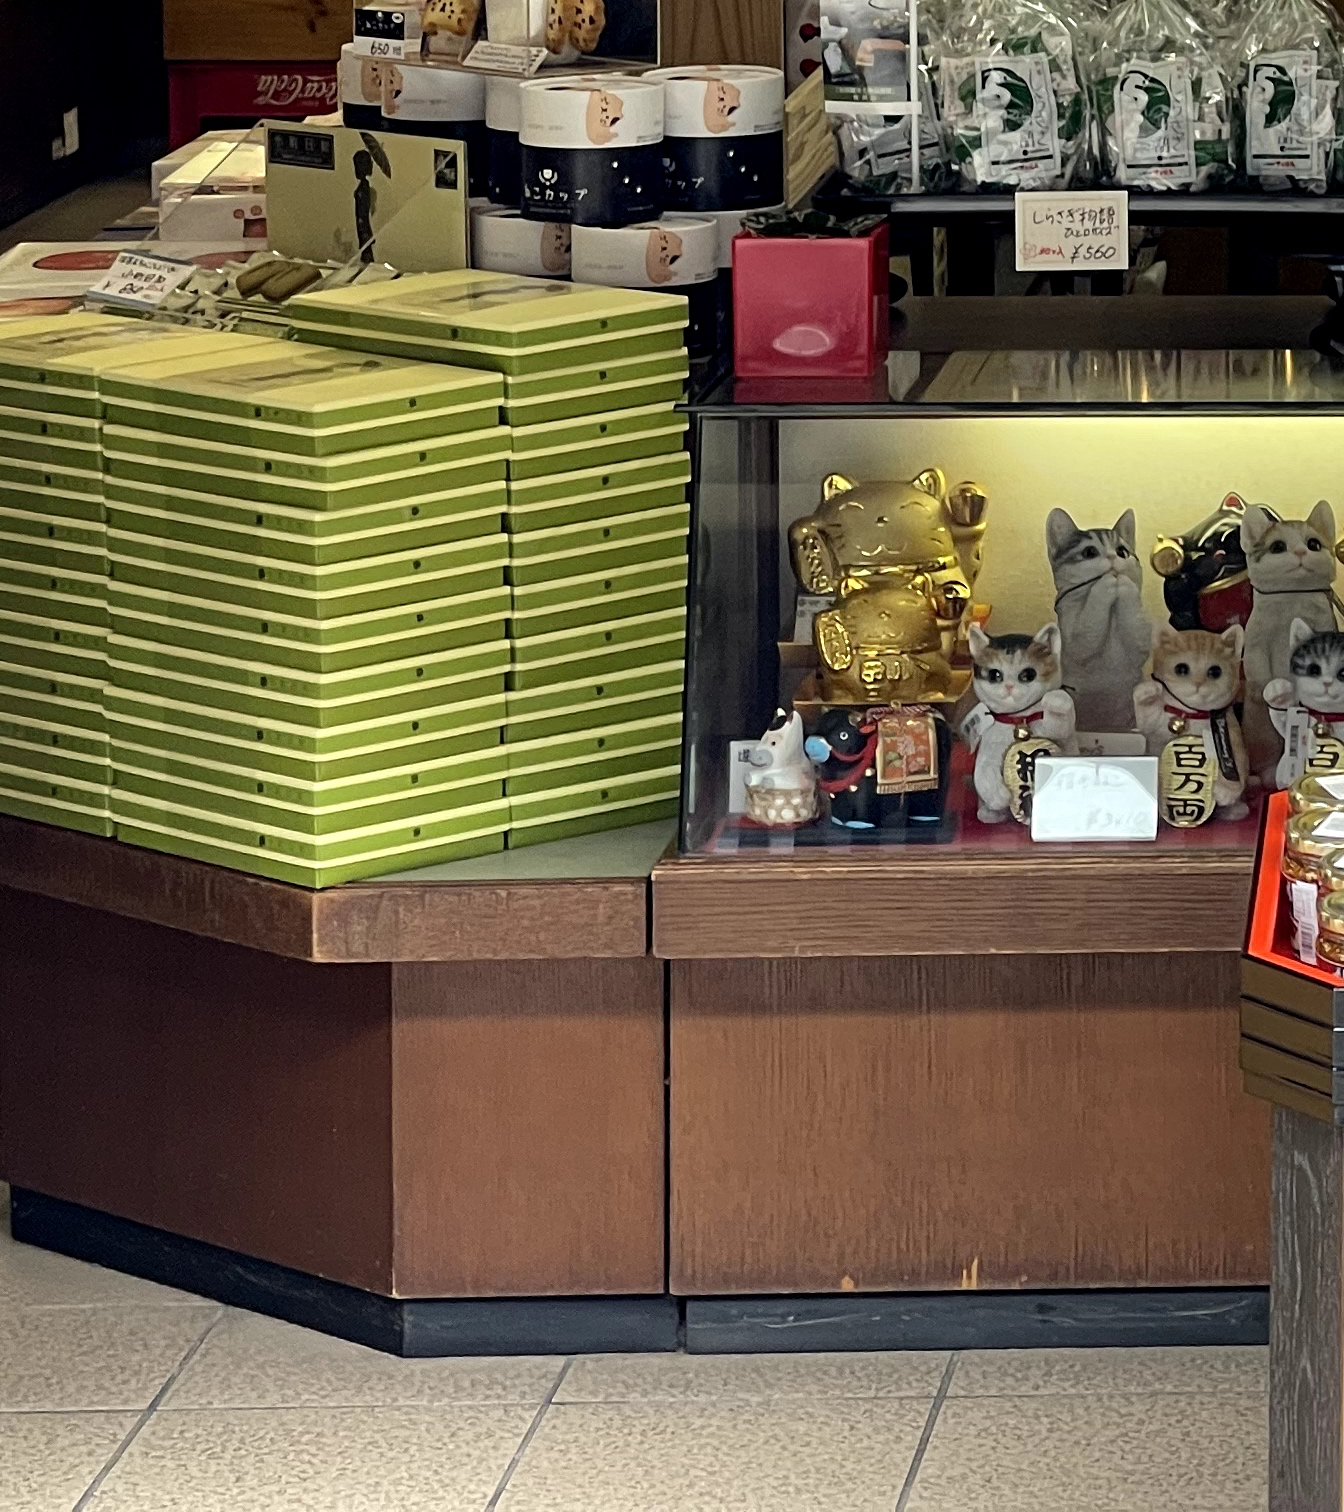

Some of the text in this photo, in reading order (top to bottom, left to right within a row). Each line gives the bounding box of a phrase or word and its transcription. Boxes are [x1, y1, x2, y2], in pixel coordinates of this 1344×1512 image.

[1070, 244, 1116, 264] ¥560
[1166, 742, 1206, 824] 百万両
